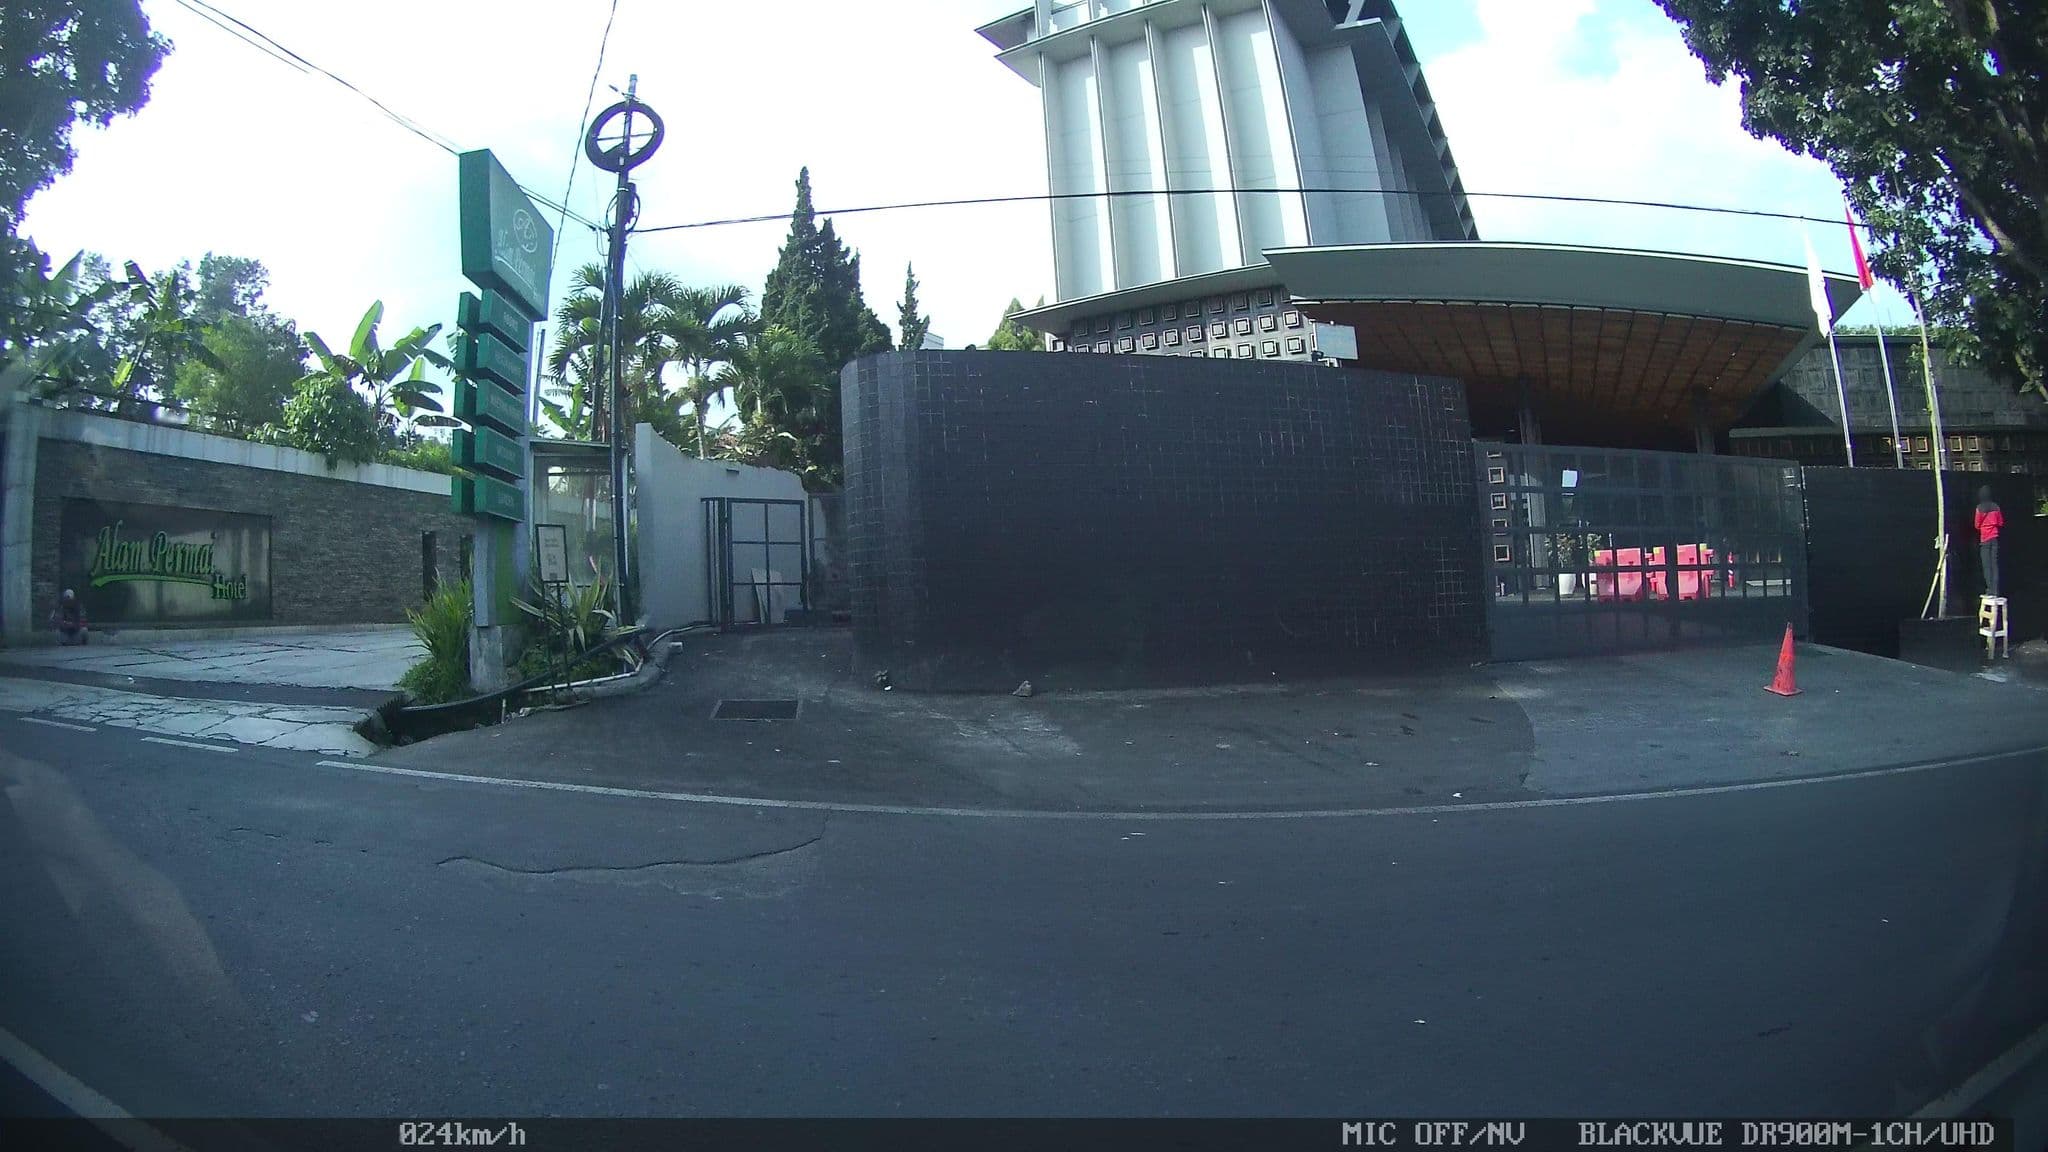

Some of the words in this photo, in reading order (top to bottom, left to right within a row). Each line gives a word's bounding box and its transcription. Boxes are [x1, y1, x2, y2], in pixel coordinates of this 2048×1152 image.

[90, 519, 142, 577] Alam
[149, 530, 217, 576] Permai
[211, 571, 249, 600] Hotel
